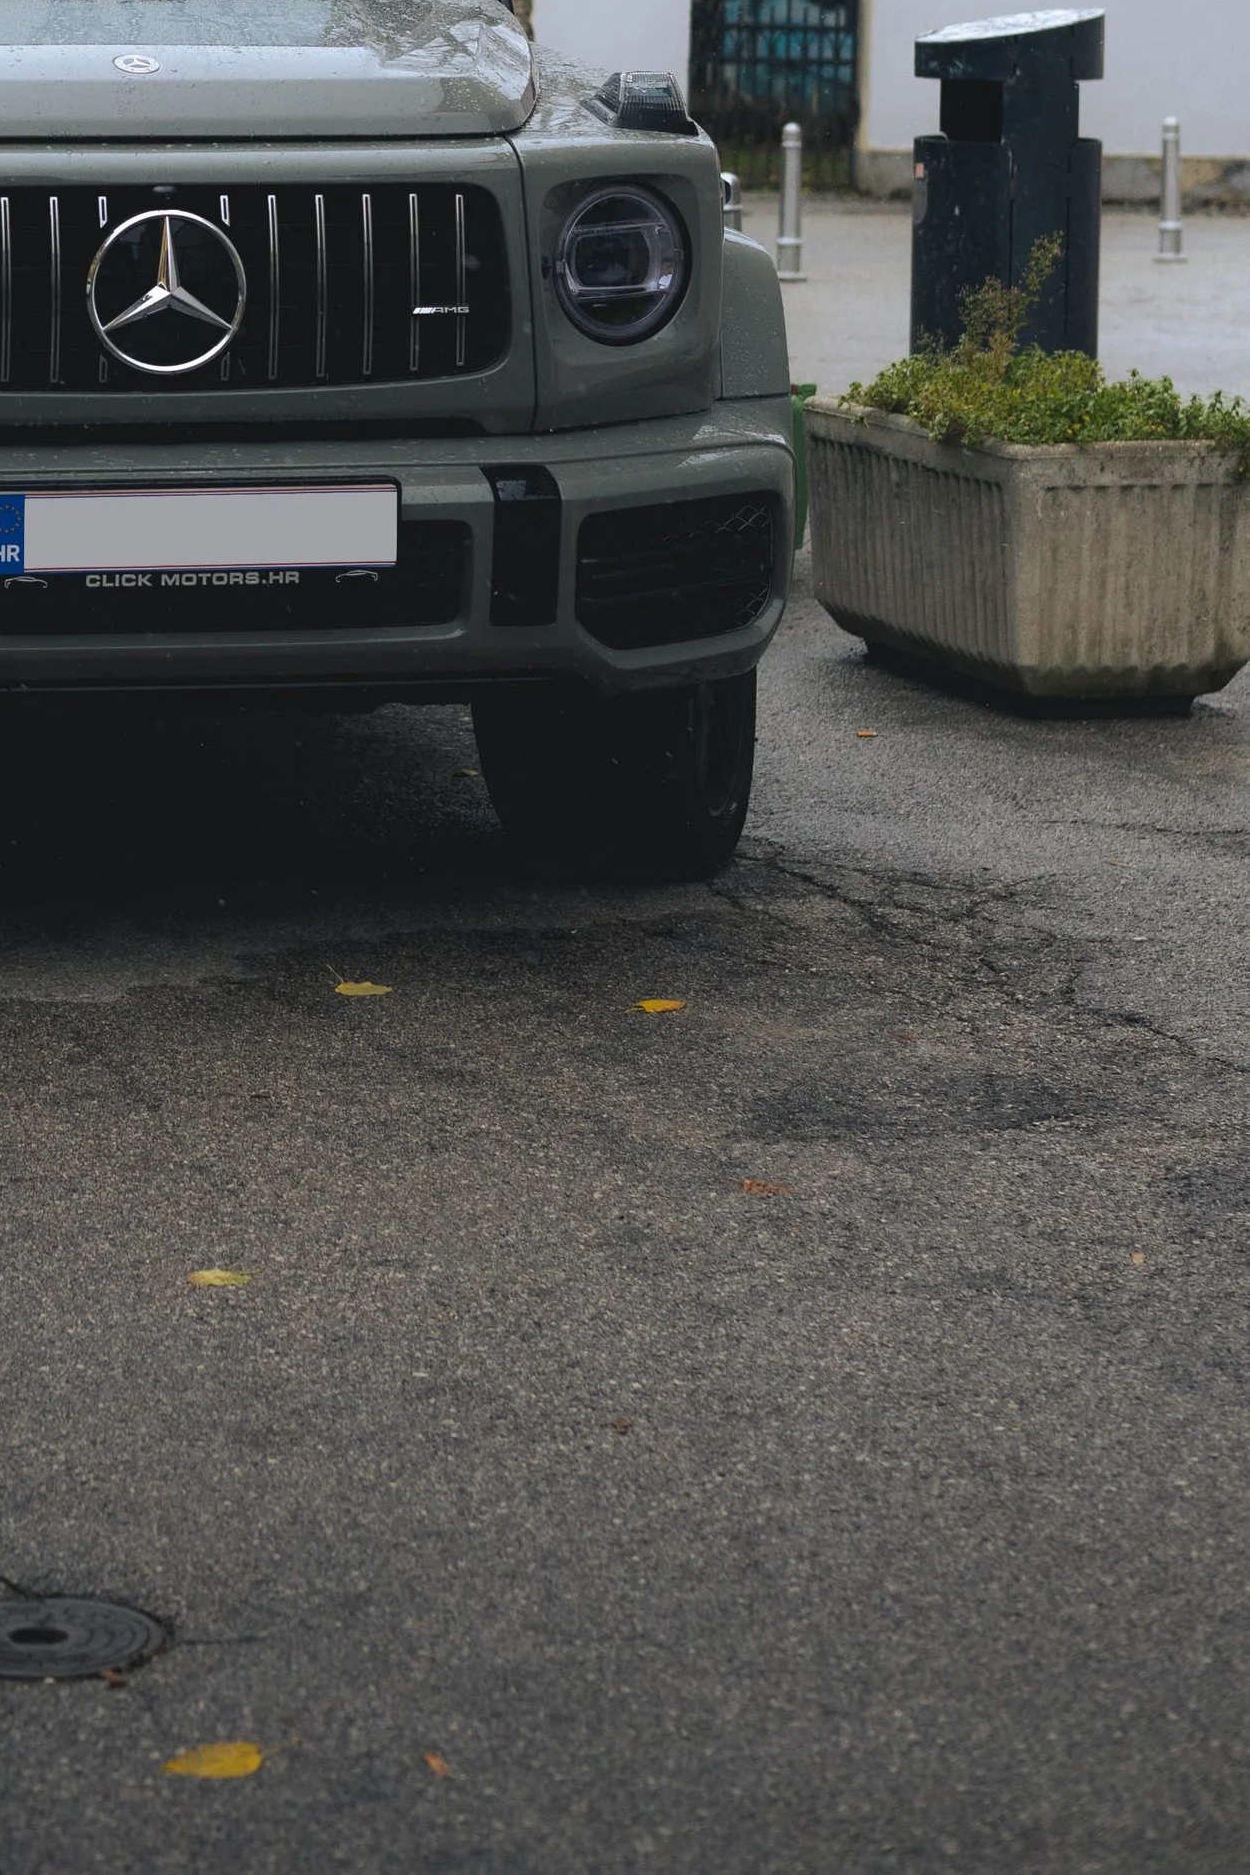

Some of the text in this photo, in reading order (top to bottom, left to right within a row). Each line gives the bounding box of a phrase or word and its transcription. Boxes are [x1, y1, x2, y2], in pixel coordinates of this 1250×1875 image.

[430, 306, 470, 314] AMG
[85, 571, 300, 588] CLICK MOTORS.HR
